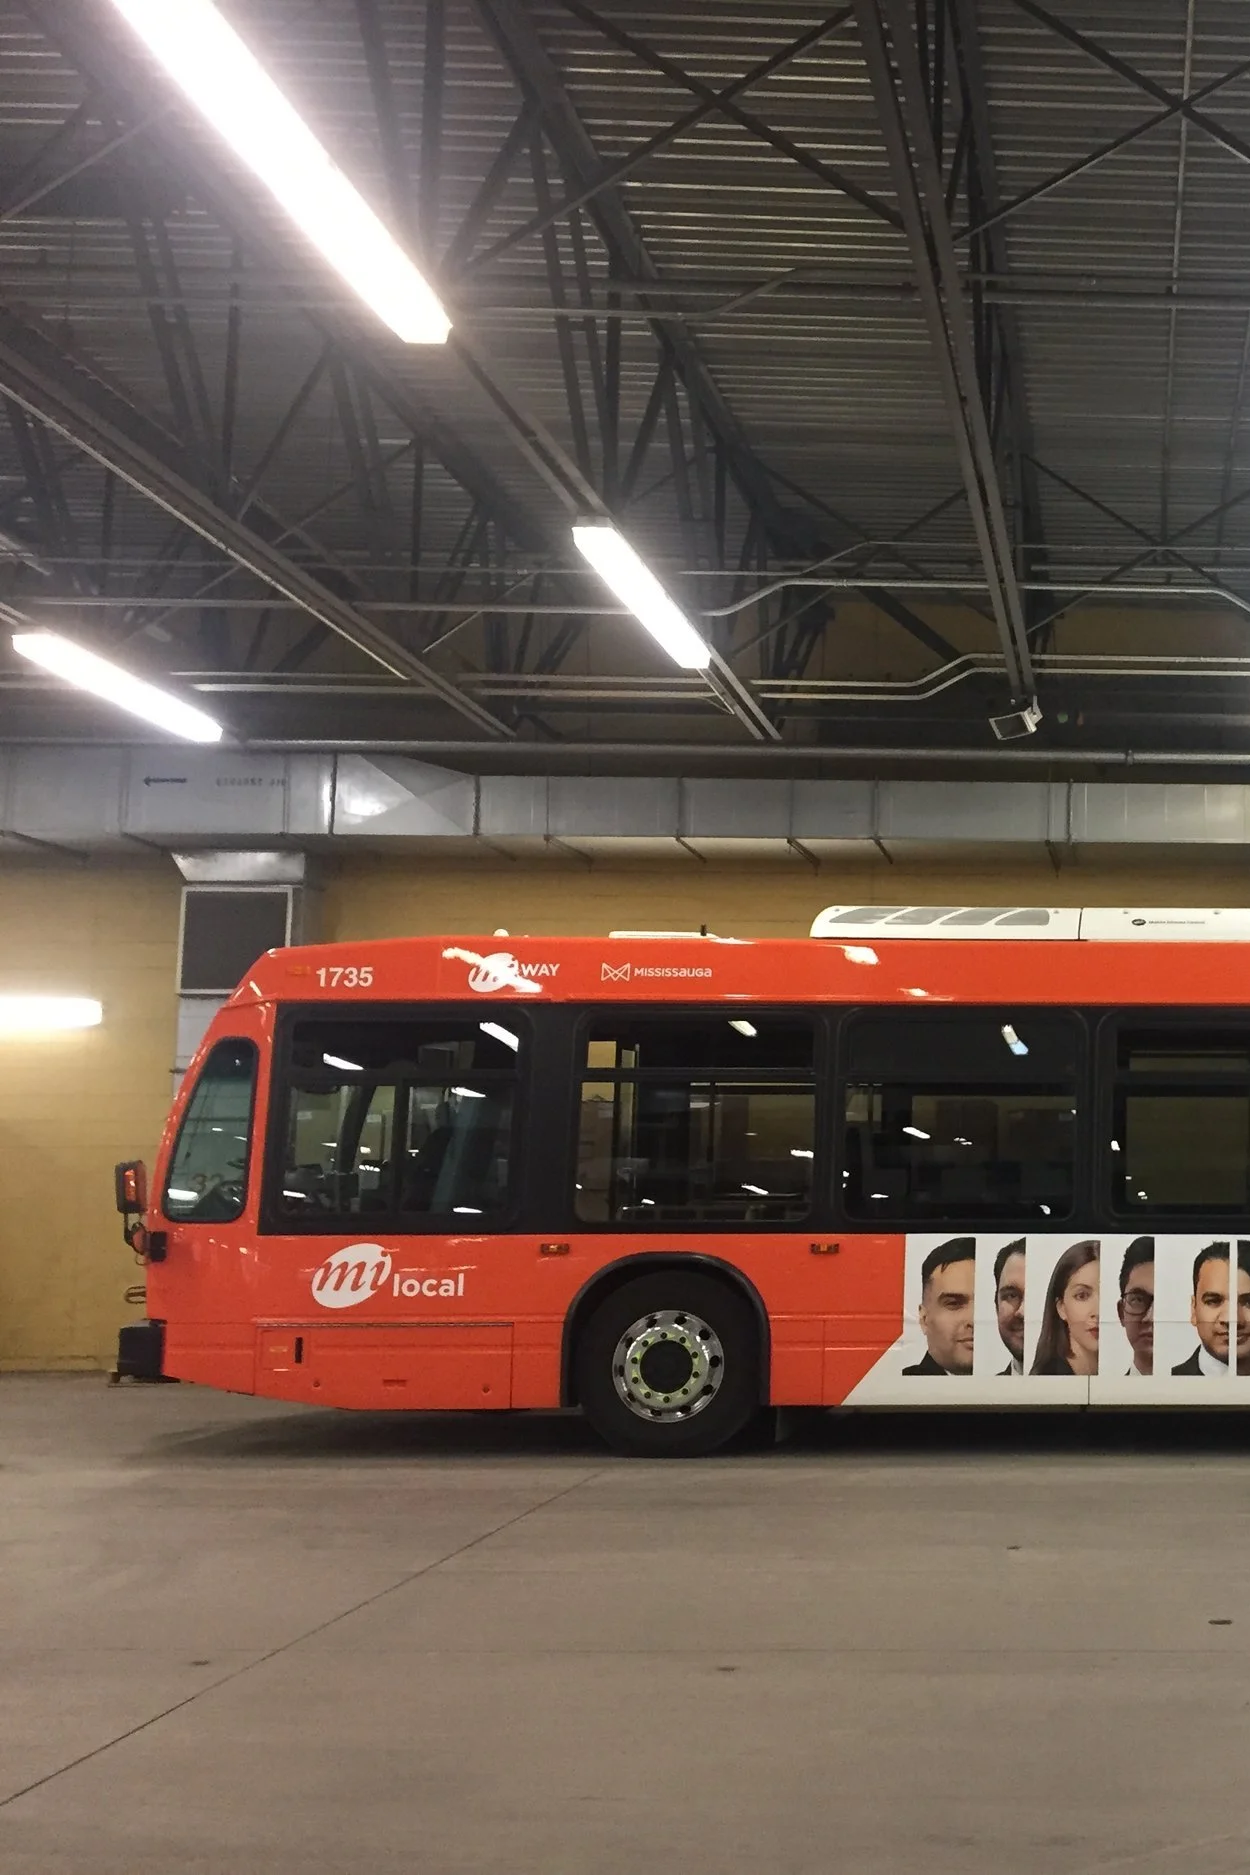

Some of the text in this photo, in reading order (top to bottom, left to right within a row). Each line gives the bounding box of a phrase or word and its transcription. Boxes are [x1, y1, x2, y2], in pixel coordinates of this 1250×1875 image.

[316, 967, 373, 987] 1735
[521, 963, 560, 976] WAY
[314, 1249, 465, 1297] mi local
